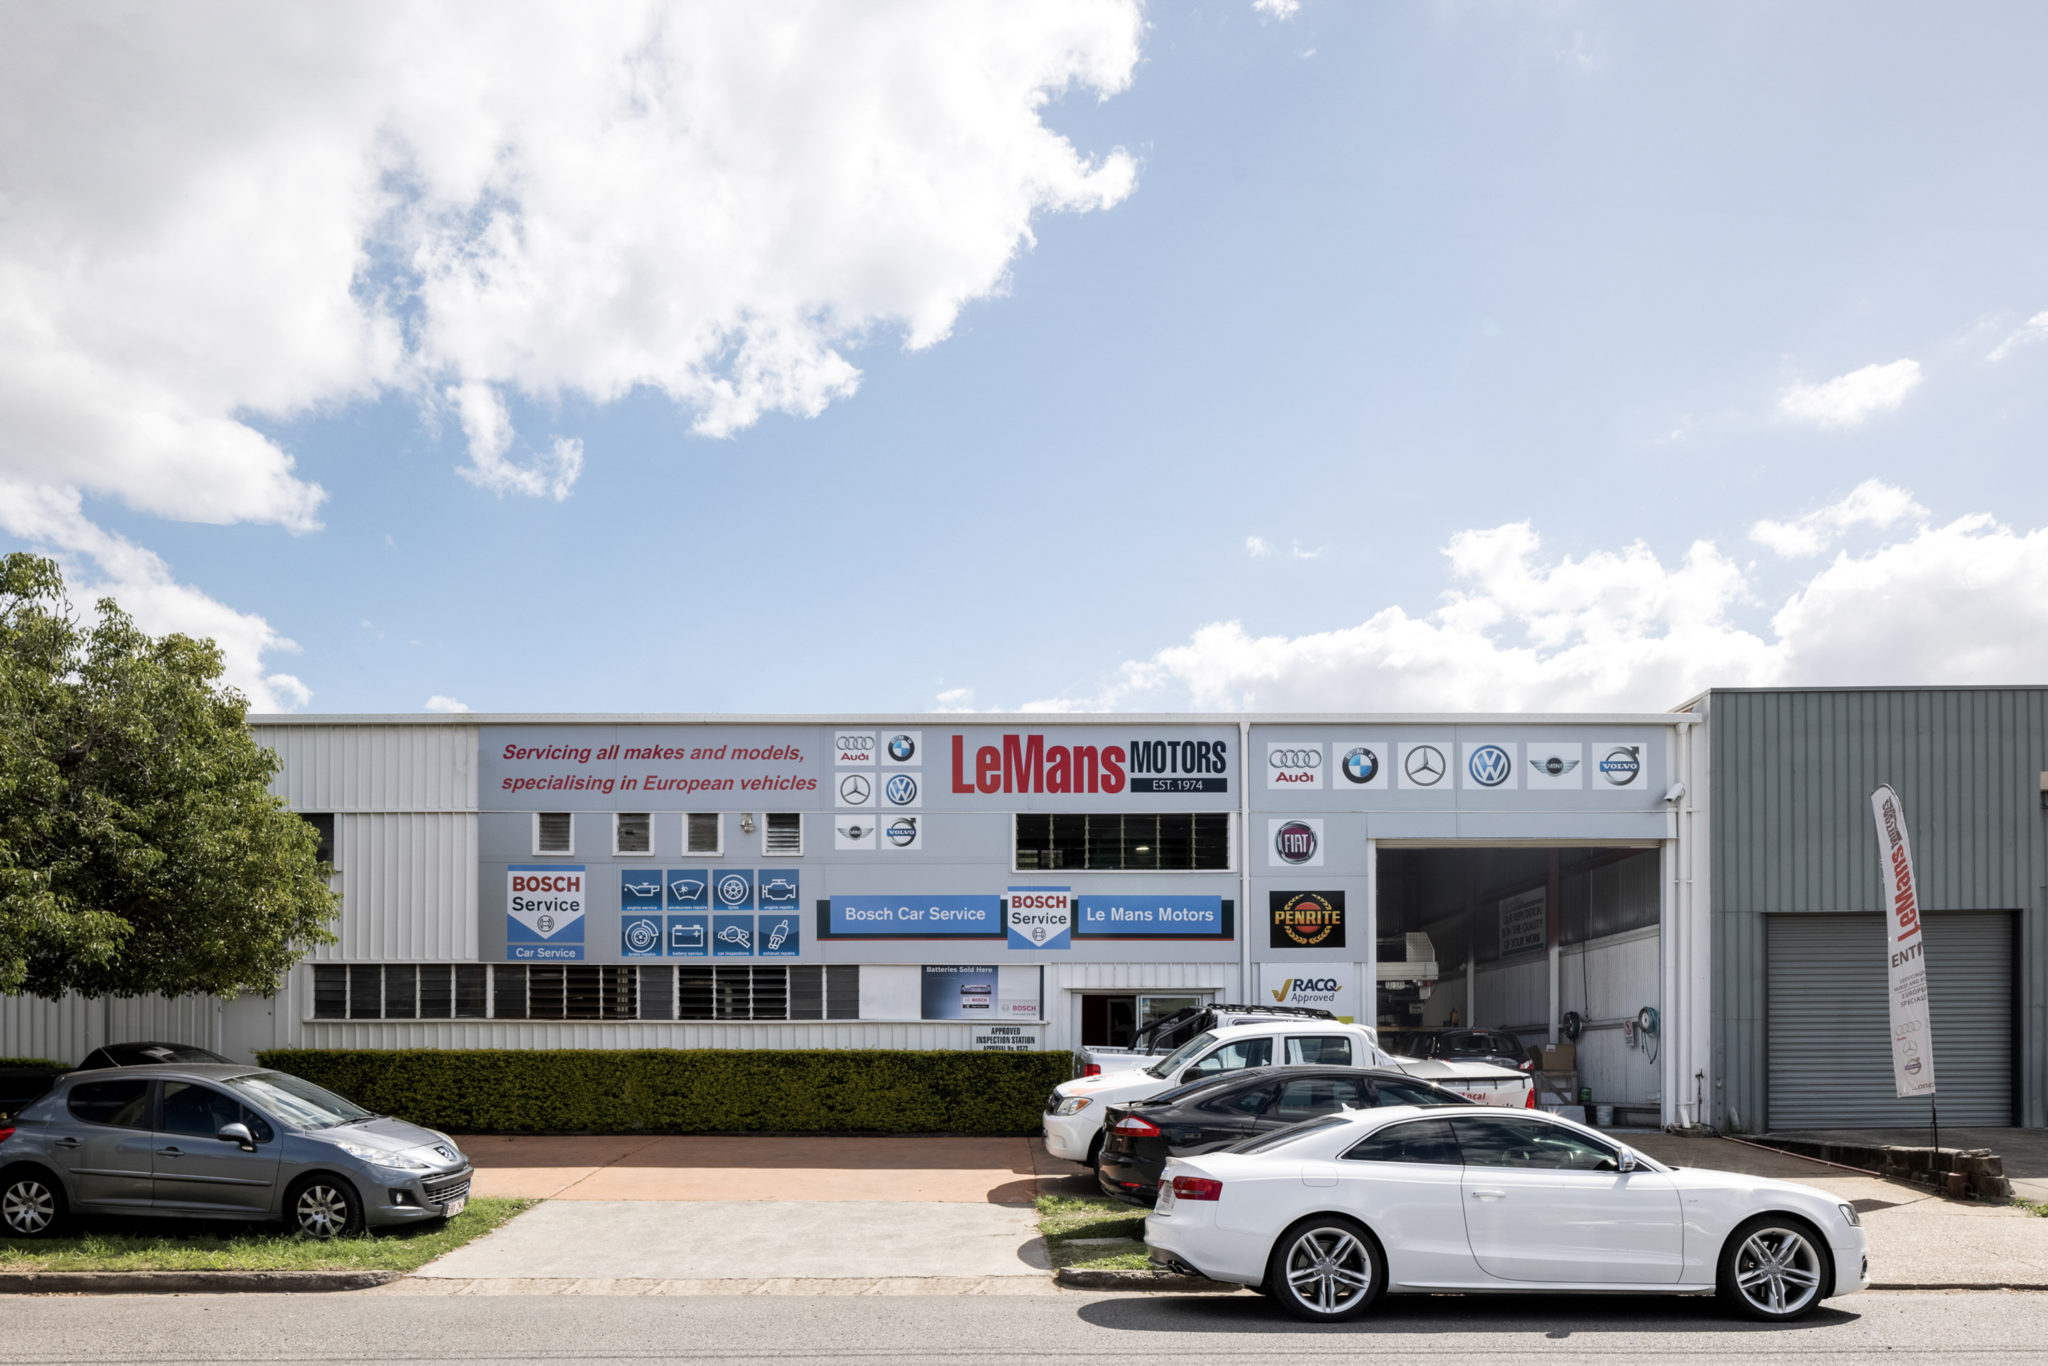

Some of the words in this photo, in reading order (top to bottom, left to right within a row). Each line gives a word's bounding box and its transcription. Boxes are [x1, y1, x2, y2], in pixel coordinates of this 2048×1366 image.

[502, 744, 592, 764] Servicing
[596, 744, 620, 760] all
[623, 744, 685, 760] makes
[690, 745, 728, 760] and
[731, 745, 804, 763] models,
[840, 752, 869, 761] Audi
[951, 734, 1126, 794] LeMans
[1130, 740, 1227, 774] MOTORS
[502, 774, 615, 794] specialising
[620, 775, 638, 790] in
[643, 775, 735, 794] European
[740, 775, 817, 790] vehicles
[1275, 771, 1314, 783] Audi
[1152, 780, 1174, 790] EST.
[1177, 780, 1203, 790] 1974
[1284, 834, 1308, 853] FIAT
[512, 876, 580, 892] BOSCH
[1892, 844, 1921, 942] LeMans
[512, 896, 580, 912] Service
[1011, 895, 1067, 909] BOSCH
[845, 907, 893, 921] Bosch
[898, 907, 925, 921] Car
[929, 907, 986, 921] Service
[1011, 912, 1067, 925] Service
[1087, 907, 1105, 921] Le
[1111, 907, 1153, 921] Mans
[1159, 907, 1214, 921] Motors
[1274, 911, 1341, 925] PENRITE
[516, 948, 534, 957] Car
[537, 948, 576, 957] Service
[1292, 978, 1338, 992] RACQ
[1291, 993, 1335, 1004] Approved
[991, 1027, 1020, 1035] APPROVED
[976, 1036, 1010, 1044] INSPECTION
[1011, 1036, 1035, 1044] STATION
